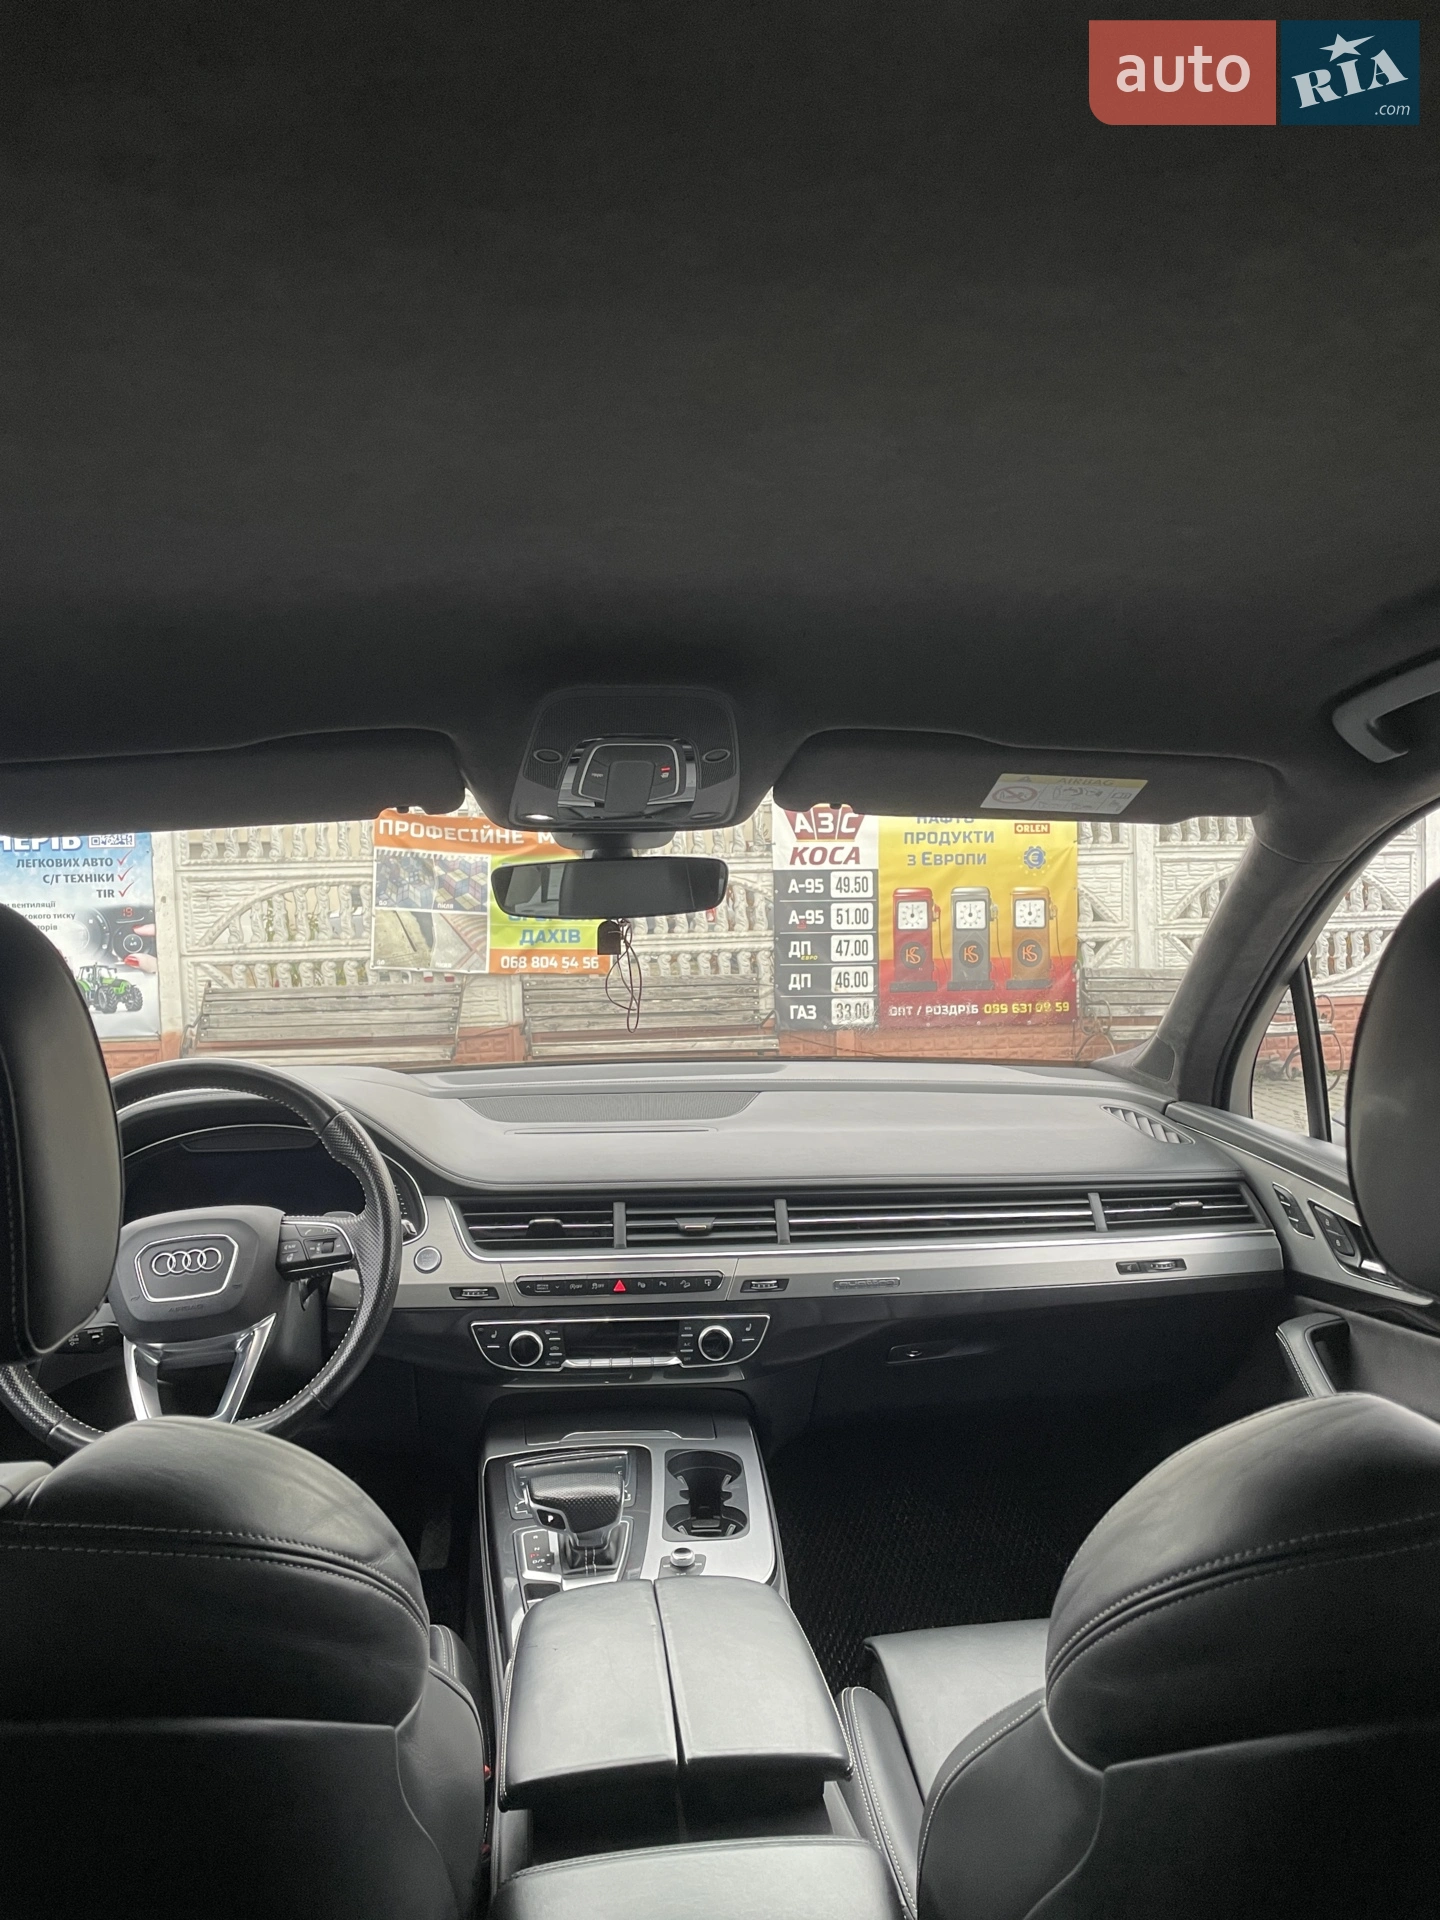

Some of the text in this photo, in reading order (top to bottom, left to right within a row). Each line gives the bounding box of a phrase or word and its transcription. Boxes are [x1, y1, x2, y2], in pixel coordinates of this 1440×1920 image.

[794, 812, 859, 833] АЗС
[1016, 824, 1048, 833] ORLEN
[379, 819, 525, 845] ПРОФЕСІЙНЕ
[904, 830, 994, 846] ПРОДУКТИ
[16, 857, 114, 869] ЛЕГКОВИХ АВТО
[789, 846, 861, 866] КОСА
[42, 873, 114, 885] С/Г ТЕХНІКИ
[787, 876, 869, 894] А-95 49.50
[96, 888, 115, 898] TIR
[11, 901, 56, 910] вентиляції
[53, 912, 76, 922] тиску
[788, 910, 825, 925] А-95
[836, 907, 869, 925] 51.00
[519, 929, 581, 946] ДАХІВ
[788, 939, 869, 958] ДП 47.00
[500, 955, 599, 969] 068 804 54 56
[788, 971, 869, 991] ДП 46.00
[789, 1004, 817, 1020] ГАЗ
[925, 1004, 979, 1016] РОЗДРІБ
[1012, 1003, 1032, 1014] 631
[1055, 1001, 1070, 1012] 59
